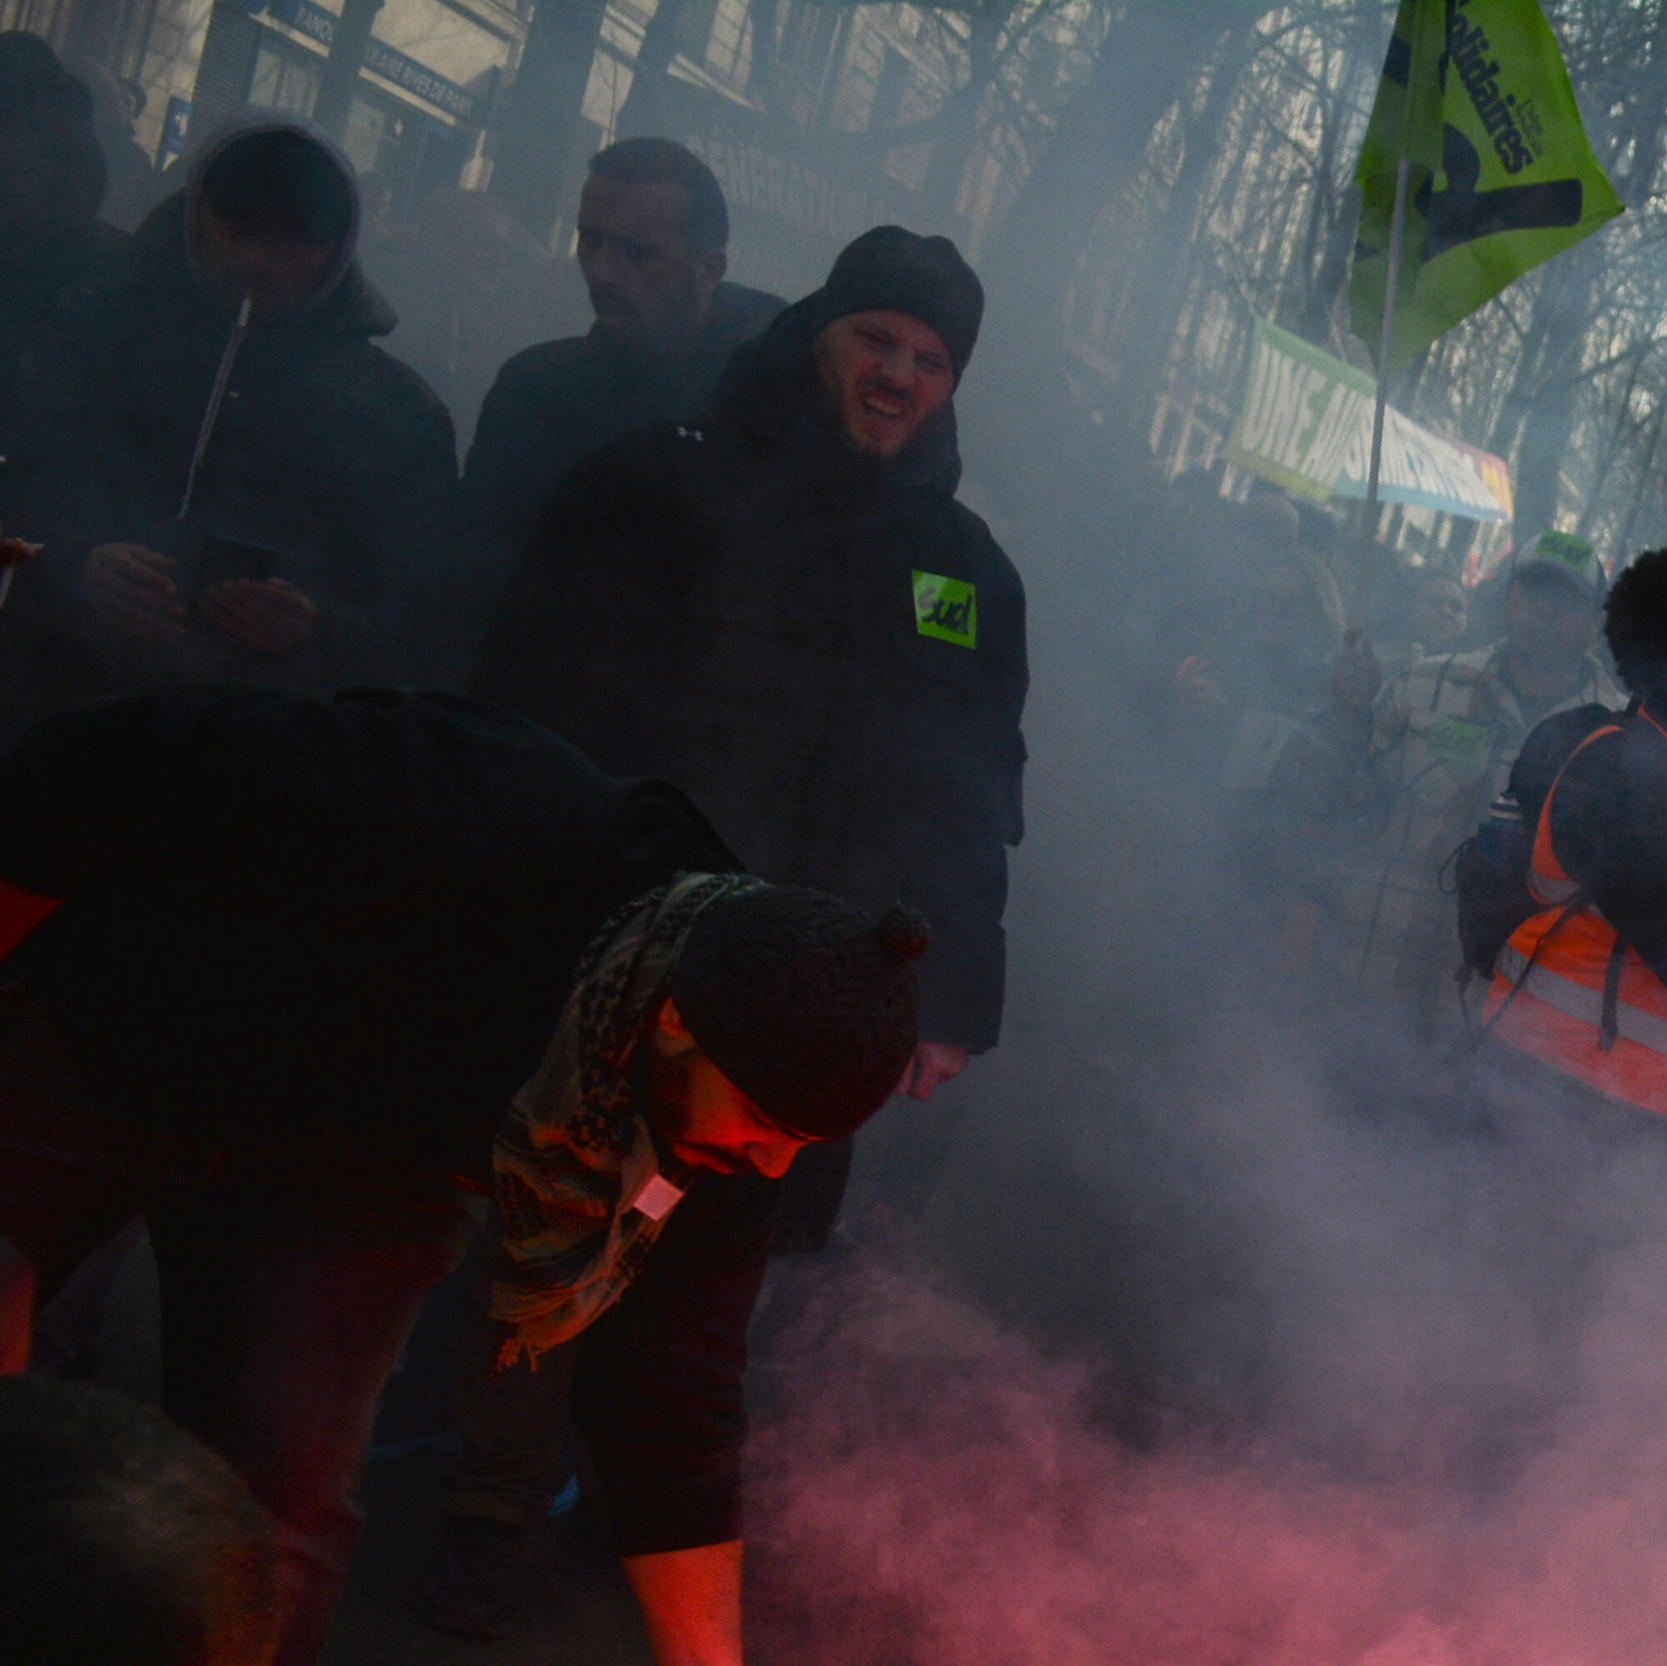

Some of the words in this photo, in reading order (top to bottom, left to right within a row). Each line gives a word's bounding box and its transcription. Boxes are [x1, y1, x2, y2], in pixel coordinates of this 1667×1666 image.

[1451, 0, 1534, 175] olidaires
[1241, 343, 1327, 469] UNE
[919, 586, 973, 635] Sud
